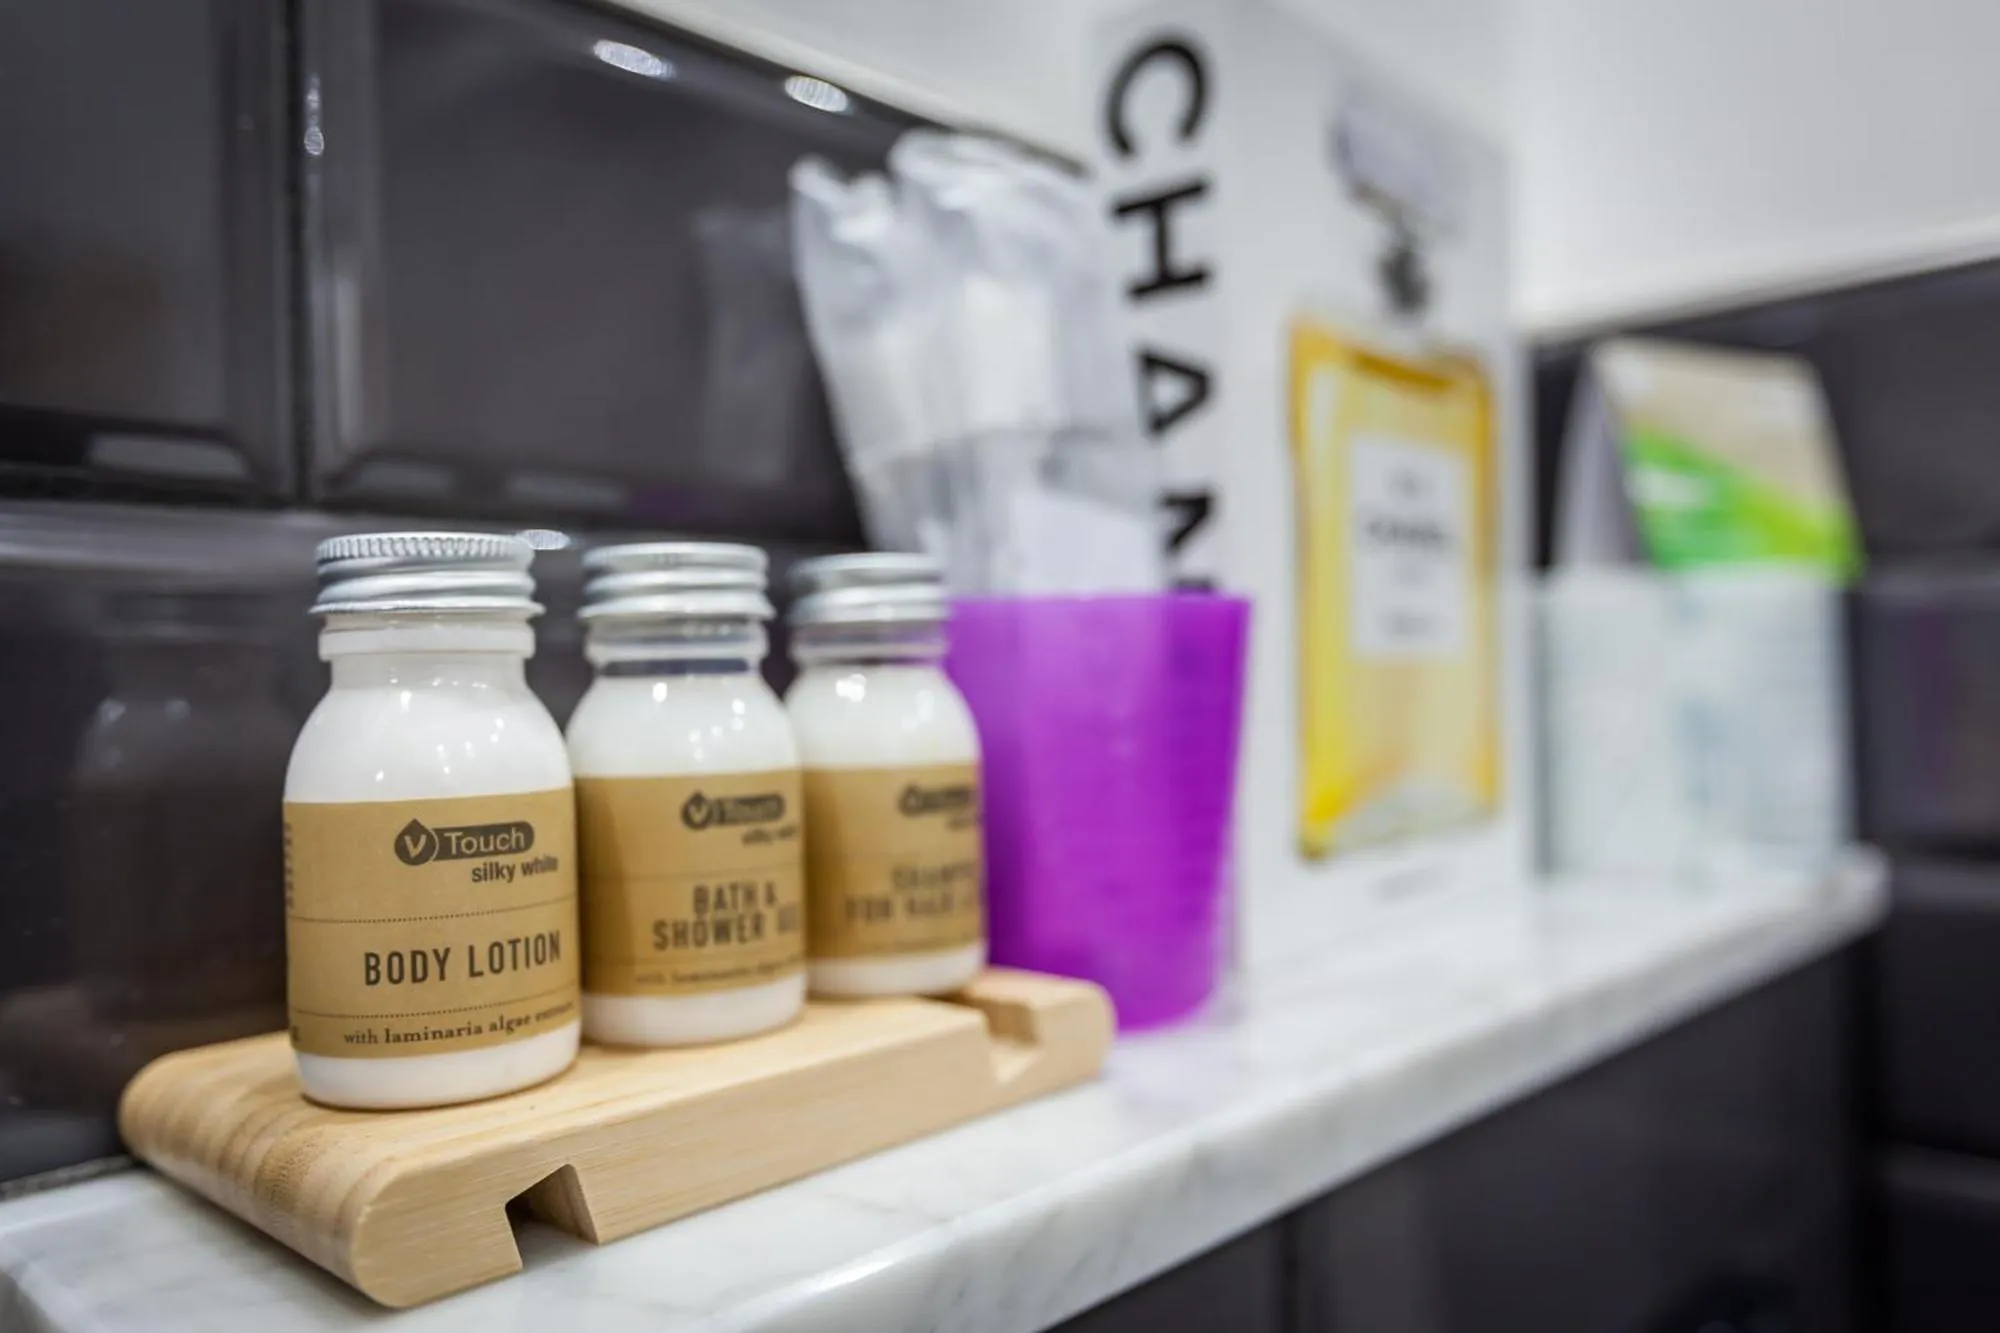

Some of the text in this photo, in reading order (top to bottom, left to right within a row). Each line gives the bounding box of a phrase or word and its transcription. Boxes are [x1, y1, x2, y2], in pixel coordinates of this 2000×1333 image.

[444, 827, 525, 855] Touch
[471, 860, 515, 883] silky
[693, 881, 757, 915] BATH
[653, 911, 764, 951] SHOWER
[364, 929, 561, 987] BODY LOTION
[344, 1012, 531, 1044] with laminaria algae
